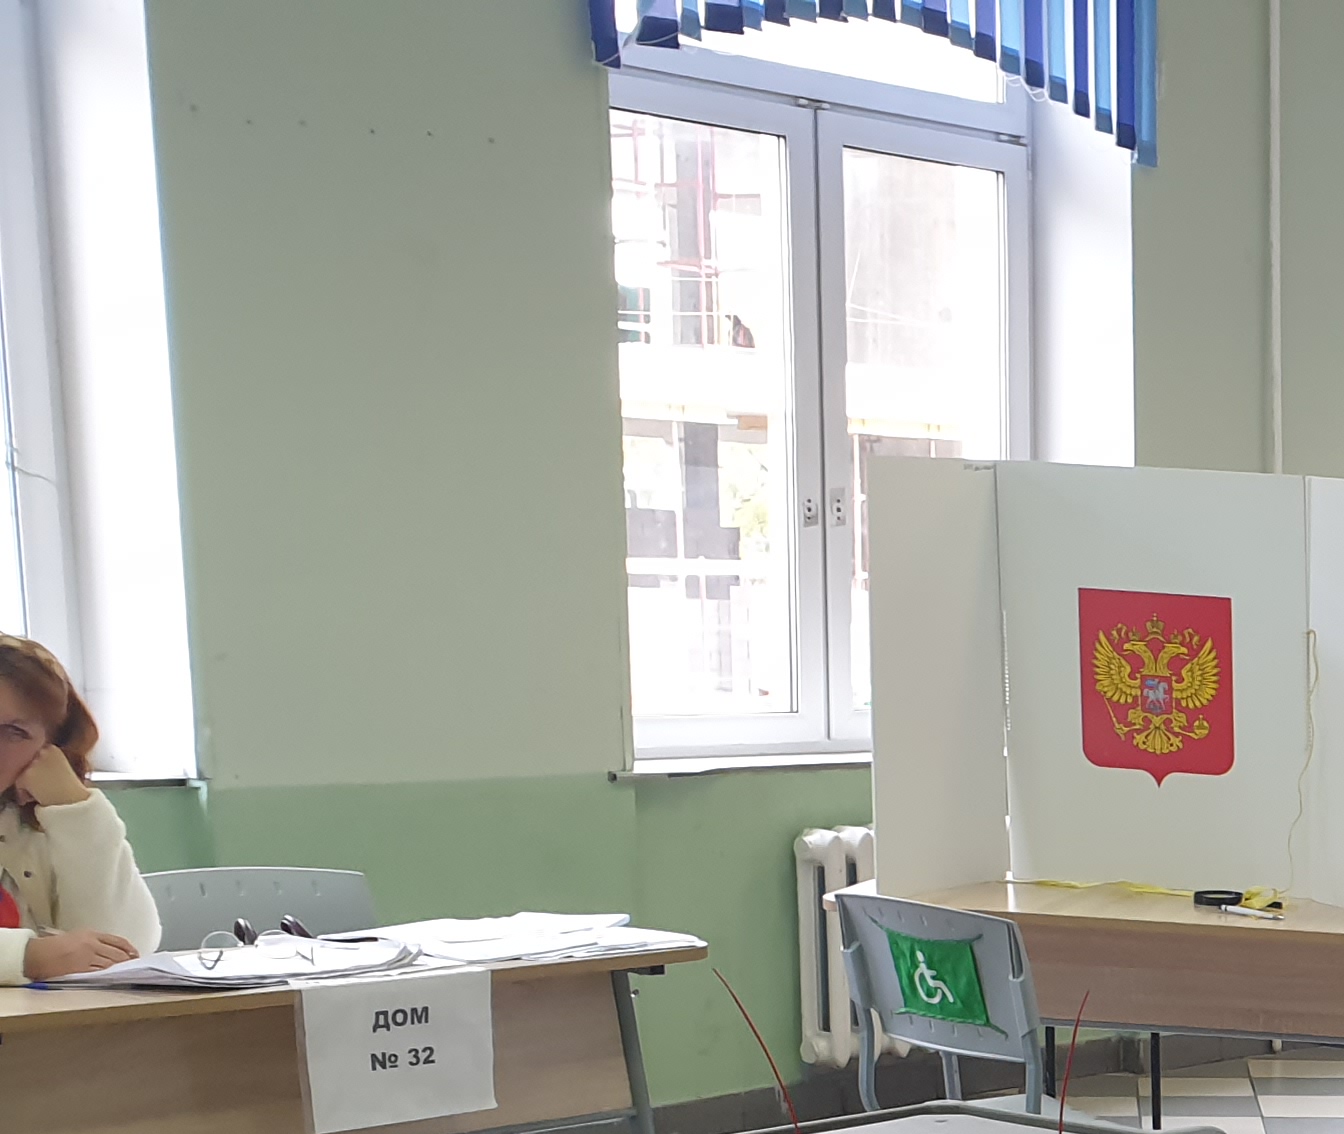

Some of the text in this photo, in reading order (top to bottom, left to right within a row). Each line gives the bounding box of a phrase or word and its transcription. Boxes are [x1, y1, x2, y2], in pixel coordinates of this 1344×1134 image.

[372, 1006, 430, 1033] ДОМ
[370, 1046, 436, 1071] № 32
